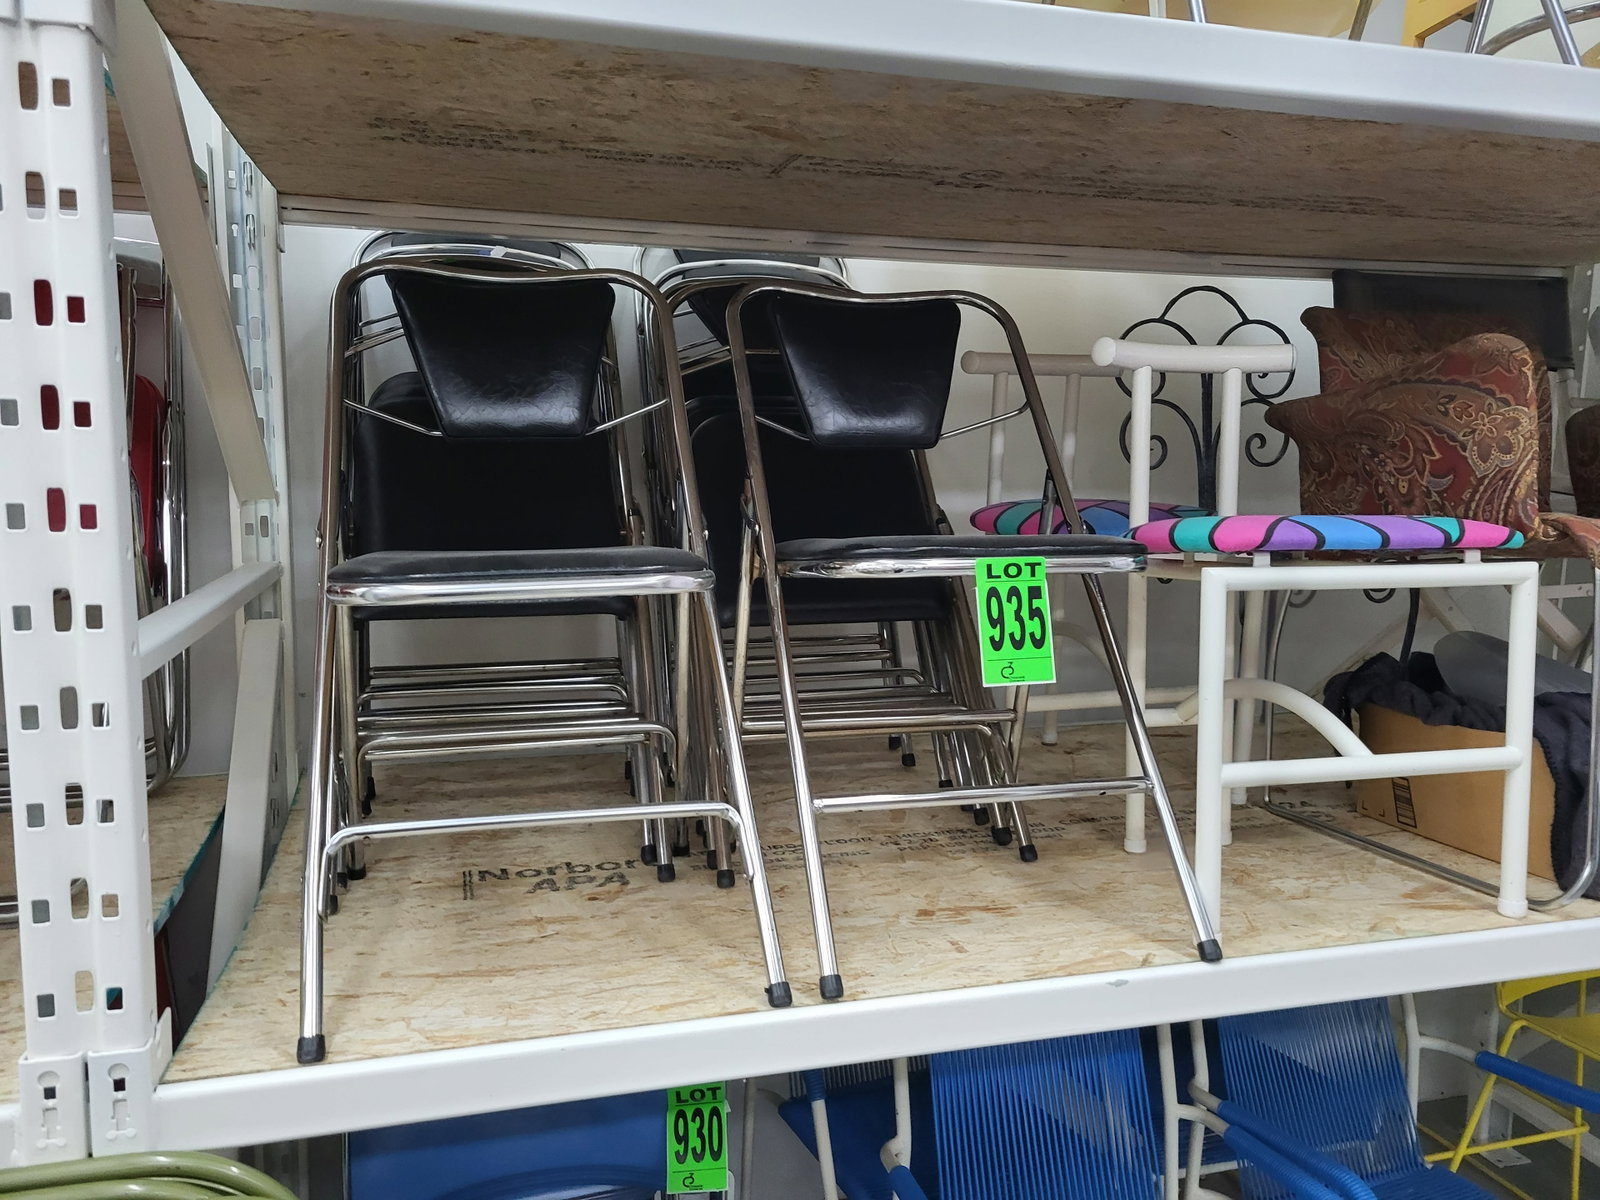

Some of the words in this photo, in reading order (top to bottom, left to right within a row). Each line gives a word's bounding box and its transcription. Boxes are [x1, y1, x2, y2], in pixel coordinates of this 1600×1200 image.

[986, 562, 1042, 579] LOT
[986, 585, 1046, 652] 935
[478, 858, 640, 882] Norbor
[526, 871, 630, 894] APA
[675, 1086, 721, 1104] LOT
[674, 1106, 723, 1165] 930
